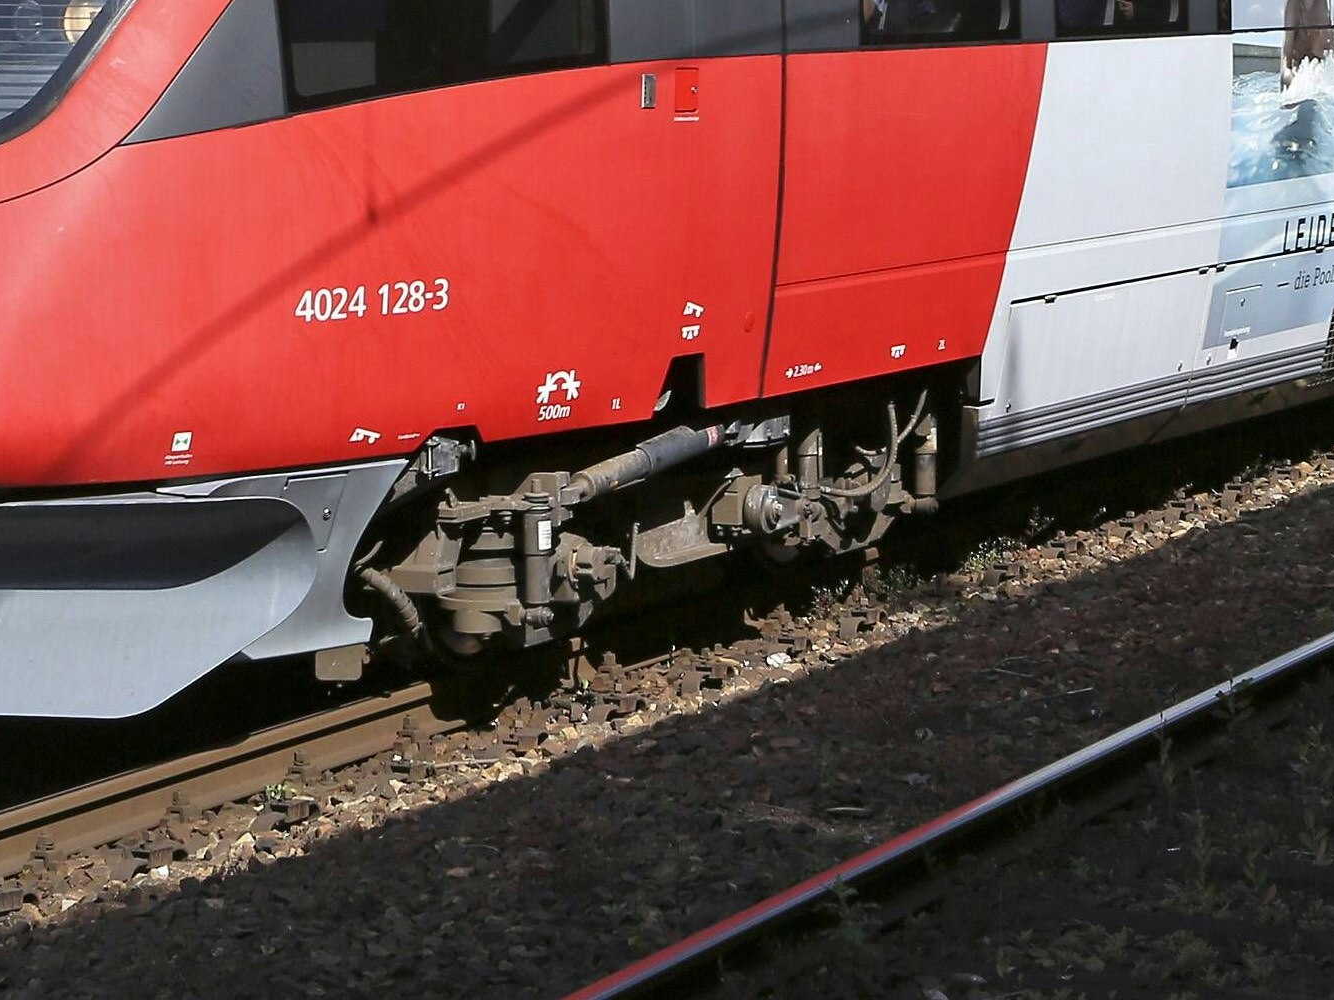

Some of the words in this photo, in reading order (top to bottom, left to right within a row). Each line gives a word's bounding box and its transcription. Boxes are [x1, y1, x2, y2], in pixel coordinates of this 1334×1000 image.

[1294, 271, 1310, 290] die
[294, 285, 367, 323] 4024
[378, 278, 450, 316] 128-3
[537, 404, 571, 422] 500m
